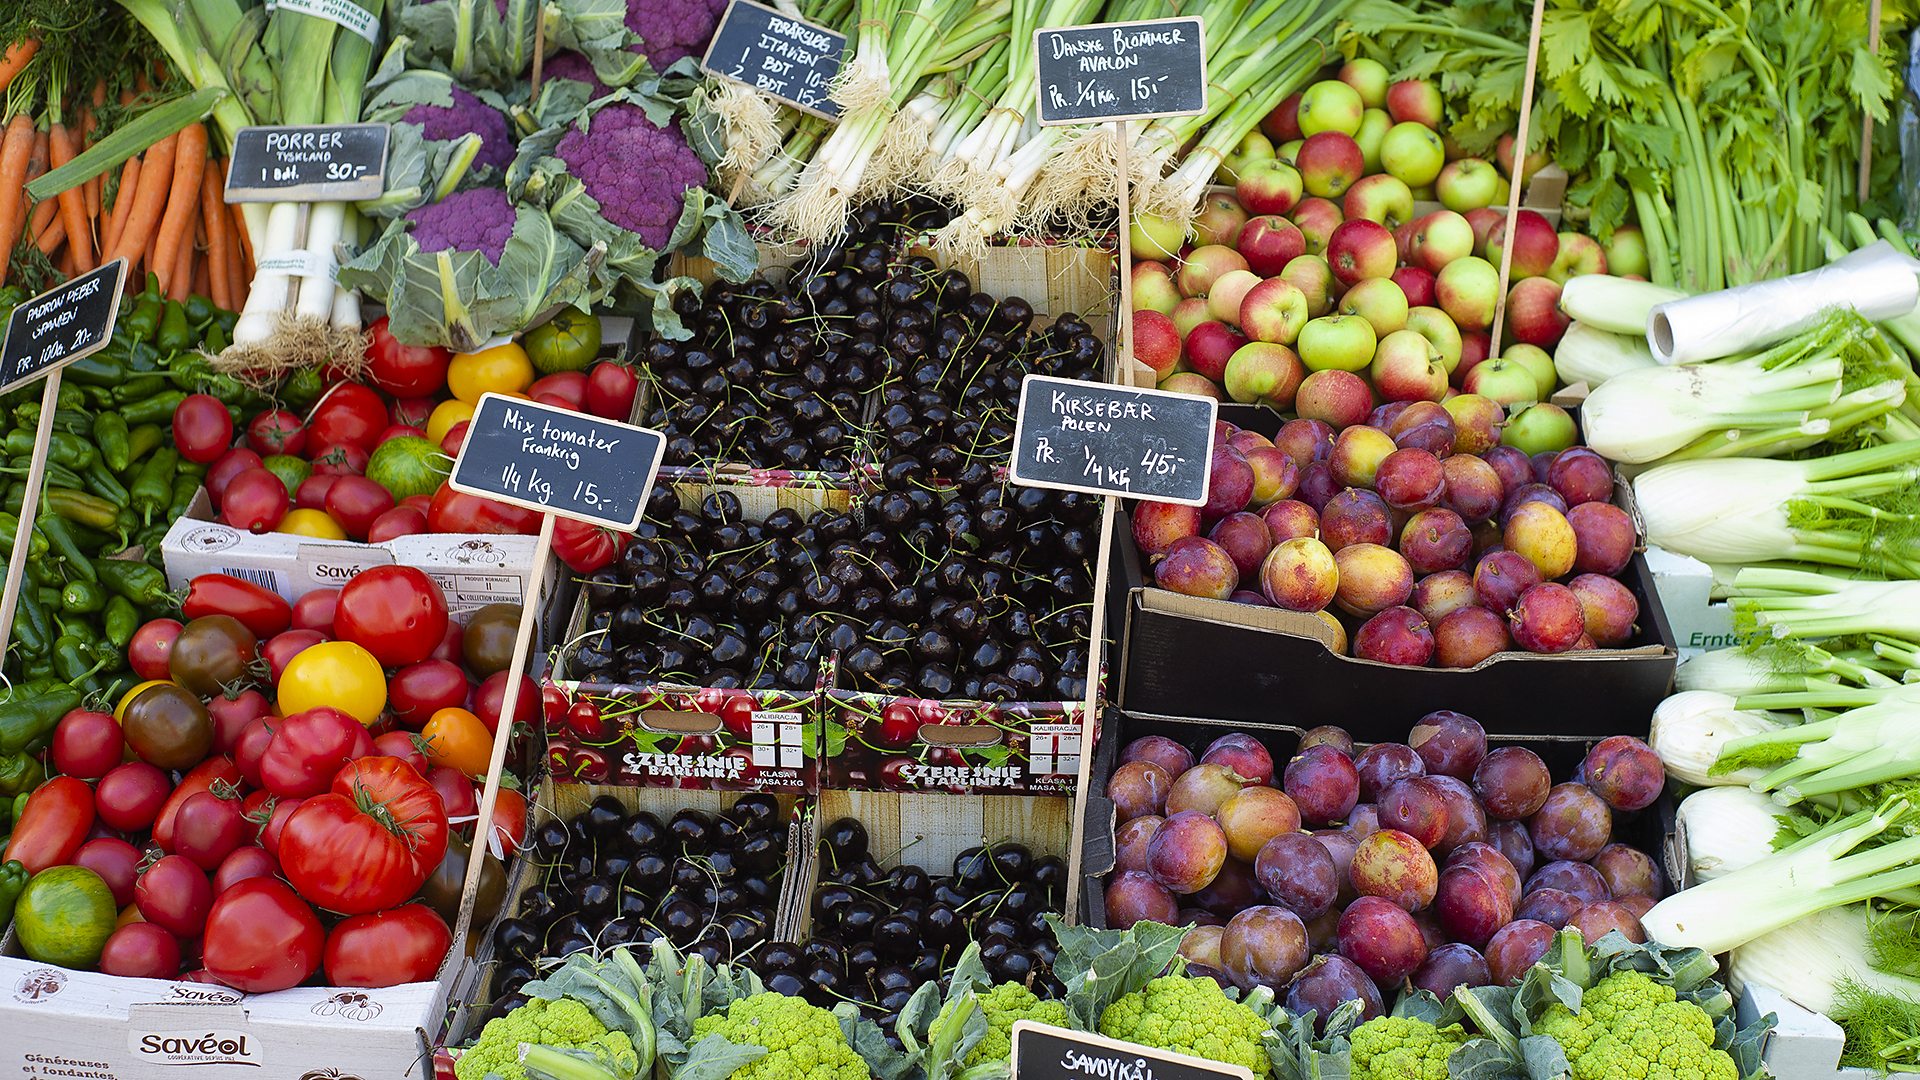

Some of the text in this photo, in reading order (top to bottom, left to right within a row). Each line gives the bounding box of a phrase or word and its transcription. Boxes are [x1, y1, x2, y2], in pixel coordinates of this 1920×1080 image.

[322, 0, 374, 23] OIREAU
[741, 47, 750, 63] 1
[762, 56, 795, 80] BDT.
[1079, 53, 1139, 73] AVALON
[728, 64, 744, 81] 2
[755, 73, 788, 97] BDT.
[1076, 78, 1096, 108] 1/4
[266, 132, 344, 152] PORRER
[276, 151, 332, 163] TYSKLAND
[262, 168, 267, 182] 1
[26, 278, 101, 324] PADRON PEBER
[32, 306, 78, 340] SPANIEN
[1051, 390, 1156, 421] KIRSEBÆR
[503, 407, 620, 454] Mix tomater
[1061, 416, 1112, 433] POLEN
[522, 437, 580, 470] Frankrig
[1083, 445, 1103, 485] 1/4
[501, 462, 522, 493] 1/4
[527, 468, 554, 505] kg.
[315, 564, 361, 578] Savé
[438, 580, 454, 589] NCE
[466, 594, 492, 602] COLLECTION
[1689, 632, 1745, 647] Ernte
[754, 713, 799, 721] KALIBRACJA
[622, 751, 747, 771] CZEREŚNIE
[629, 764, 741, 779] Z BARLINKA
[759, 770, 798, 779] KLASA 1
[899, 763, 1022, 778] CZEREŚNIE
[754, 778, 781, 786] MASA
[790, 779, 804, 787] KG
[906, 776, 1016, 787] Z BARLINKA
[1035, 777, 1066, 785] KLASA
[140, 1032, 251, 1057] Savéol
[22, 1065, 36, 1073] et
[25, 1053, 109, 1069] Généreuses
